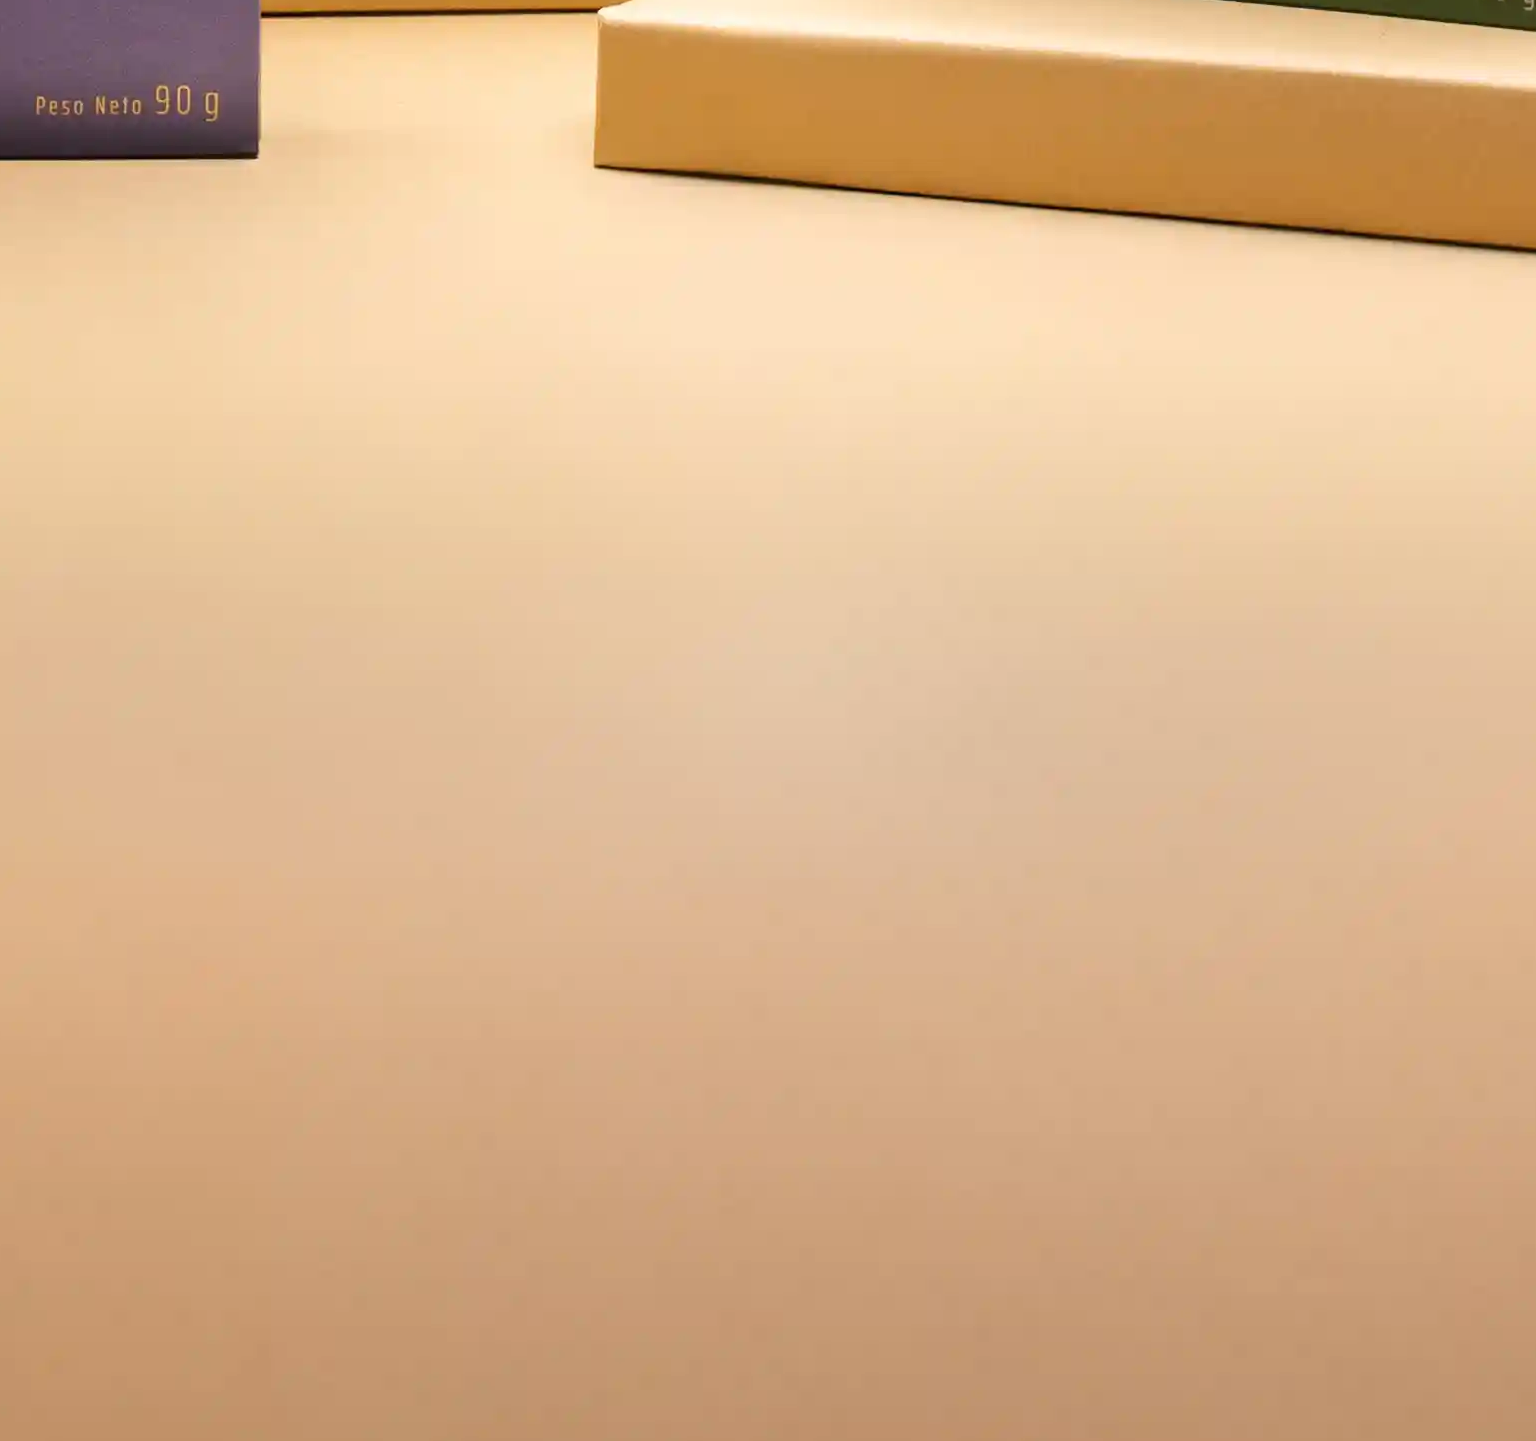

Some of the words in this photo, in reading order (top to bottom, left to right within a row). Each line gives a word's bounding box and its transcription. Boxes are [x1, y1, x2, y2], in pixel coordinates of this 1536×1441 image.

[36, 96, 84, 116] Peso
[95, 96, 142, 116] Neto
[155, 85, 191, 115] 90
[204, 91, 220, 122] g
